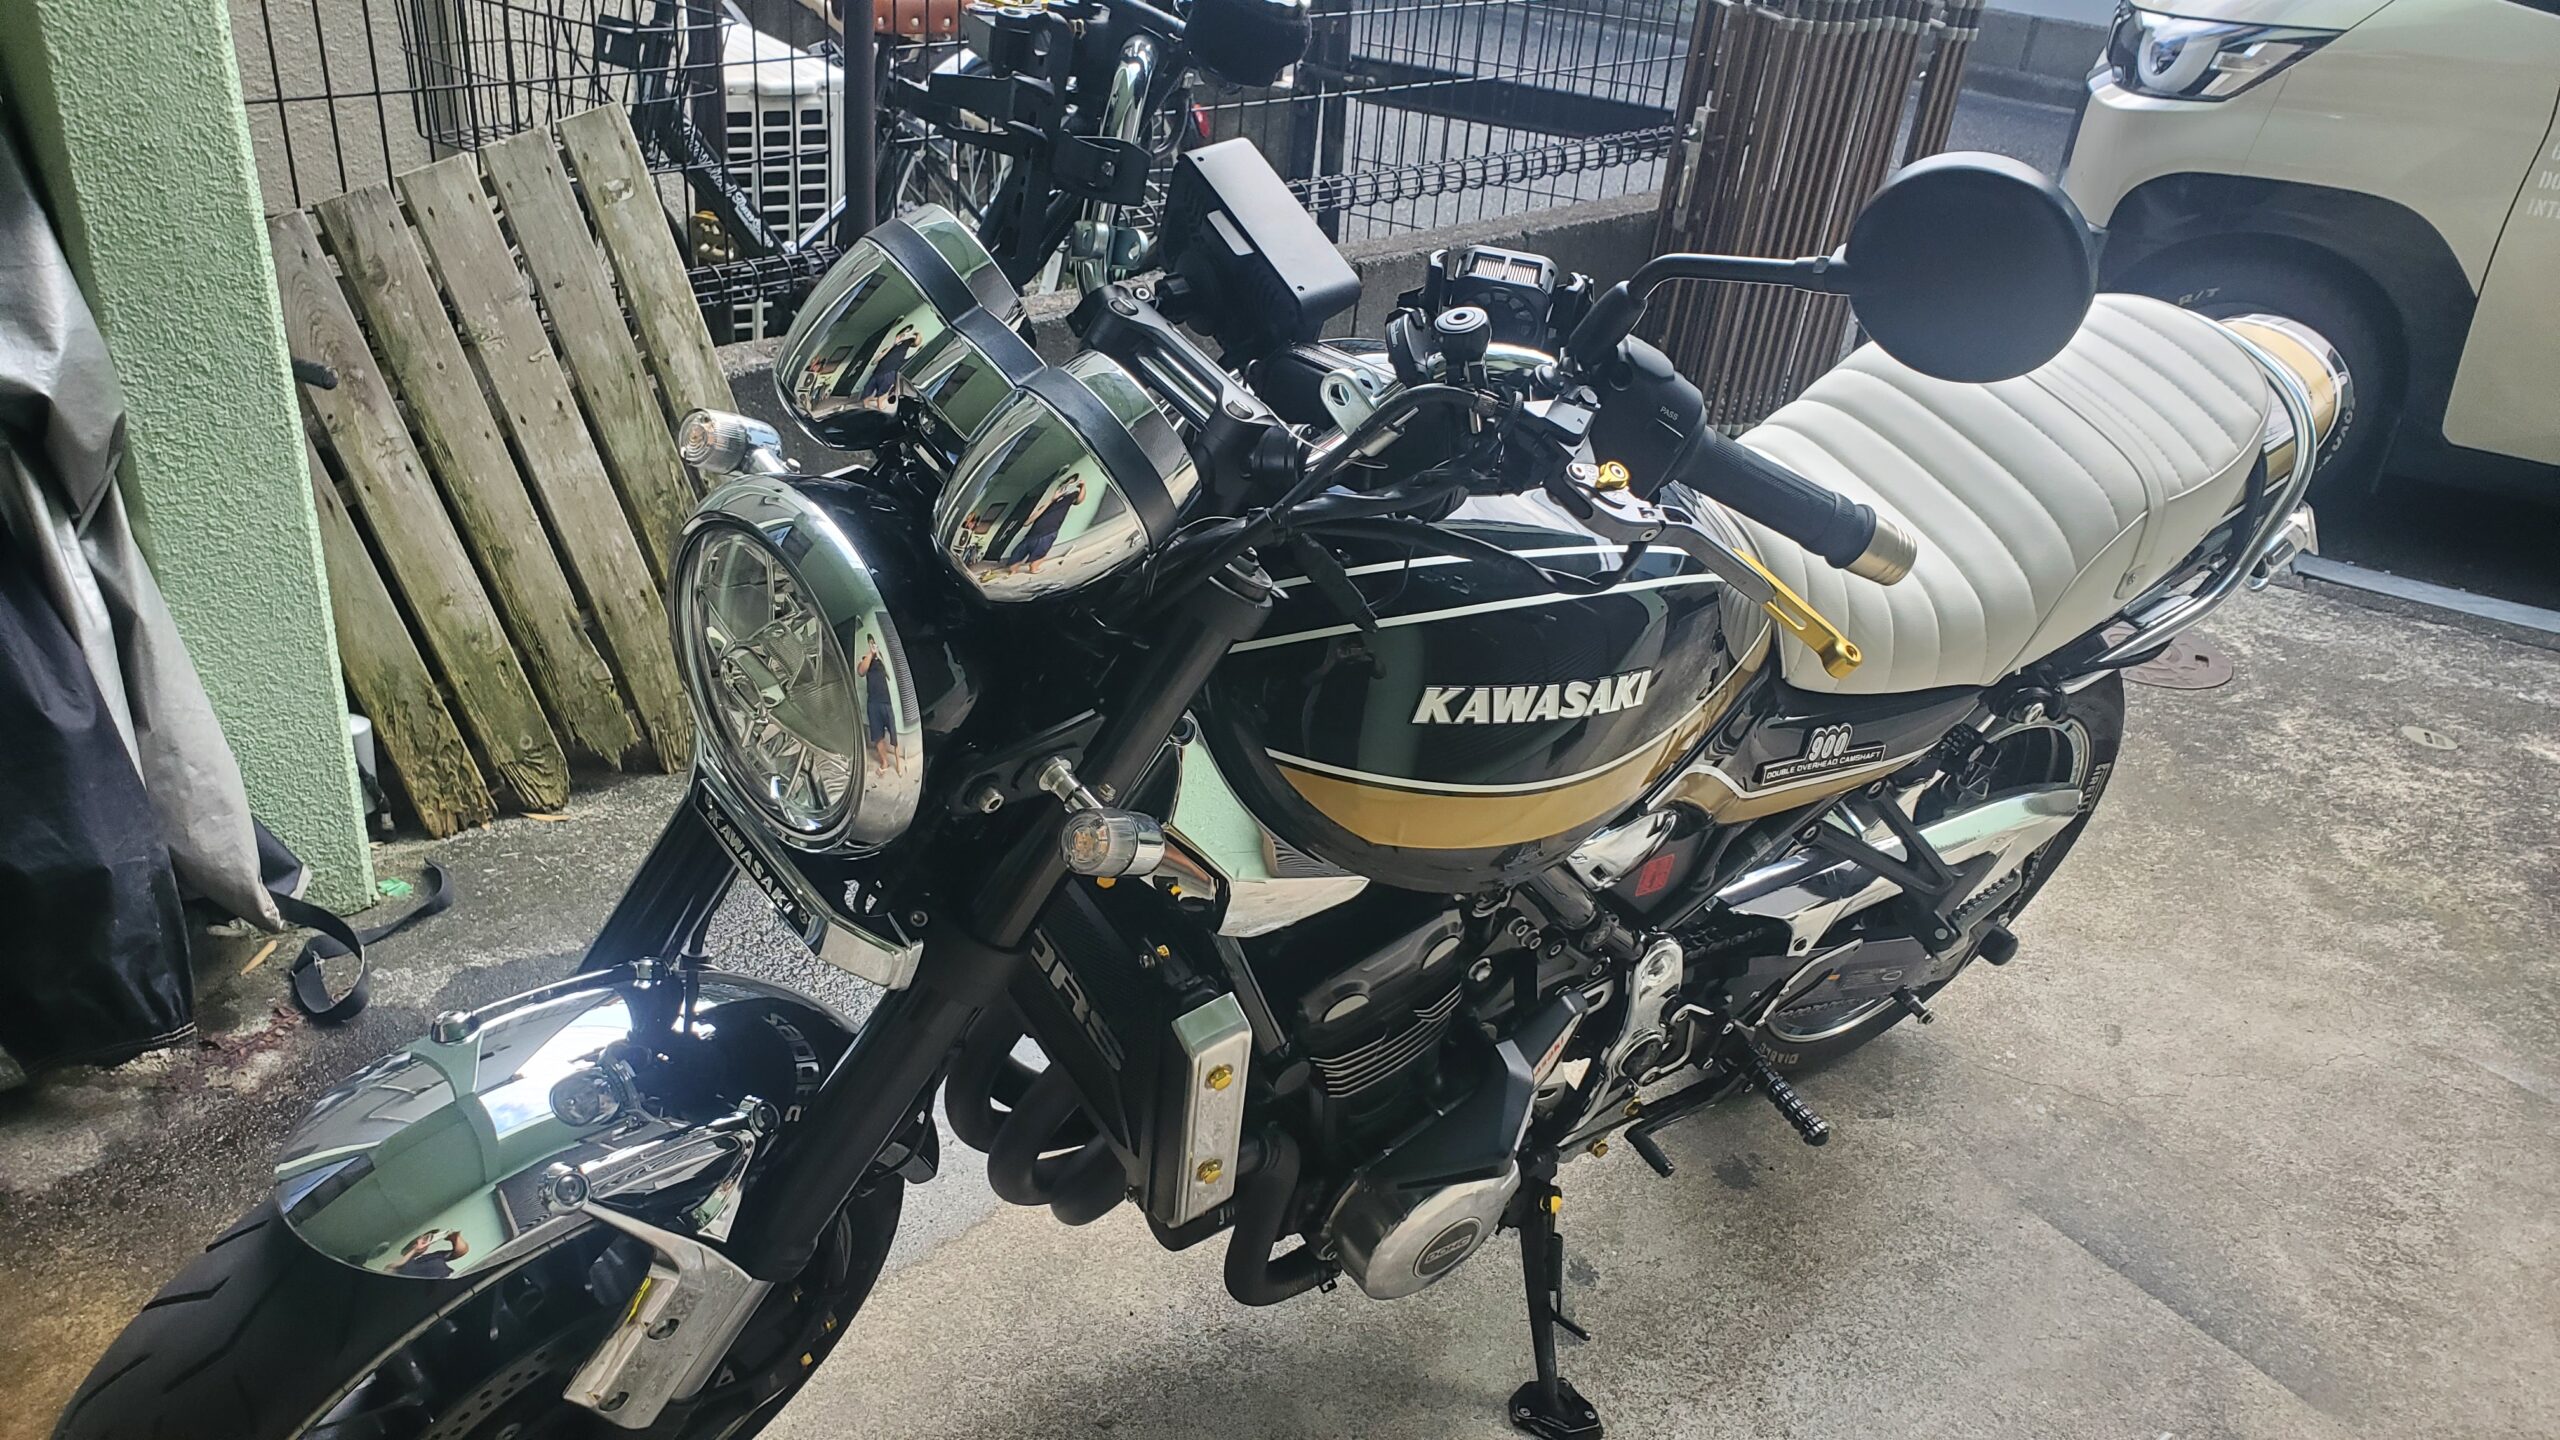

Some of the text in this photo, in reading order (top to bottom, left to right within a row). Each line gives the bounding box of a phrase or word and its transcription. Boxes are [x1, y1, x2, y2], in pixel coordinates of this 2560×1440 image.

[1660, 405, 1680, 421] PASS
[1411, 669, 1653, 725] KAWASAKI
[1808, 731, 1850, 761] 900
[1766, 750, 1882, 780] DOUBLE OVERHEAD CAMSHAFT
[2079, 762, 2111, 812] PIRELLI
[706, 809, 794, 915] KAWASAKI
[1758, 1042, 1800, 1065] DIABLO
